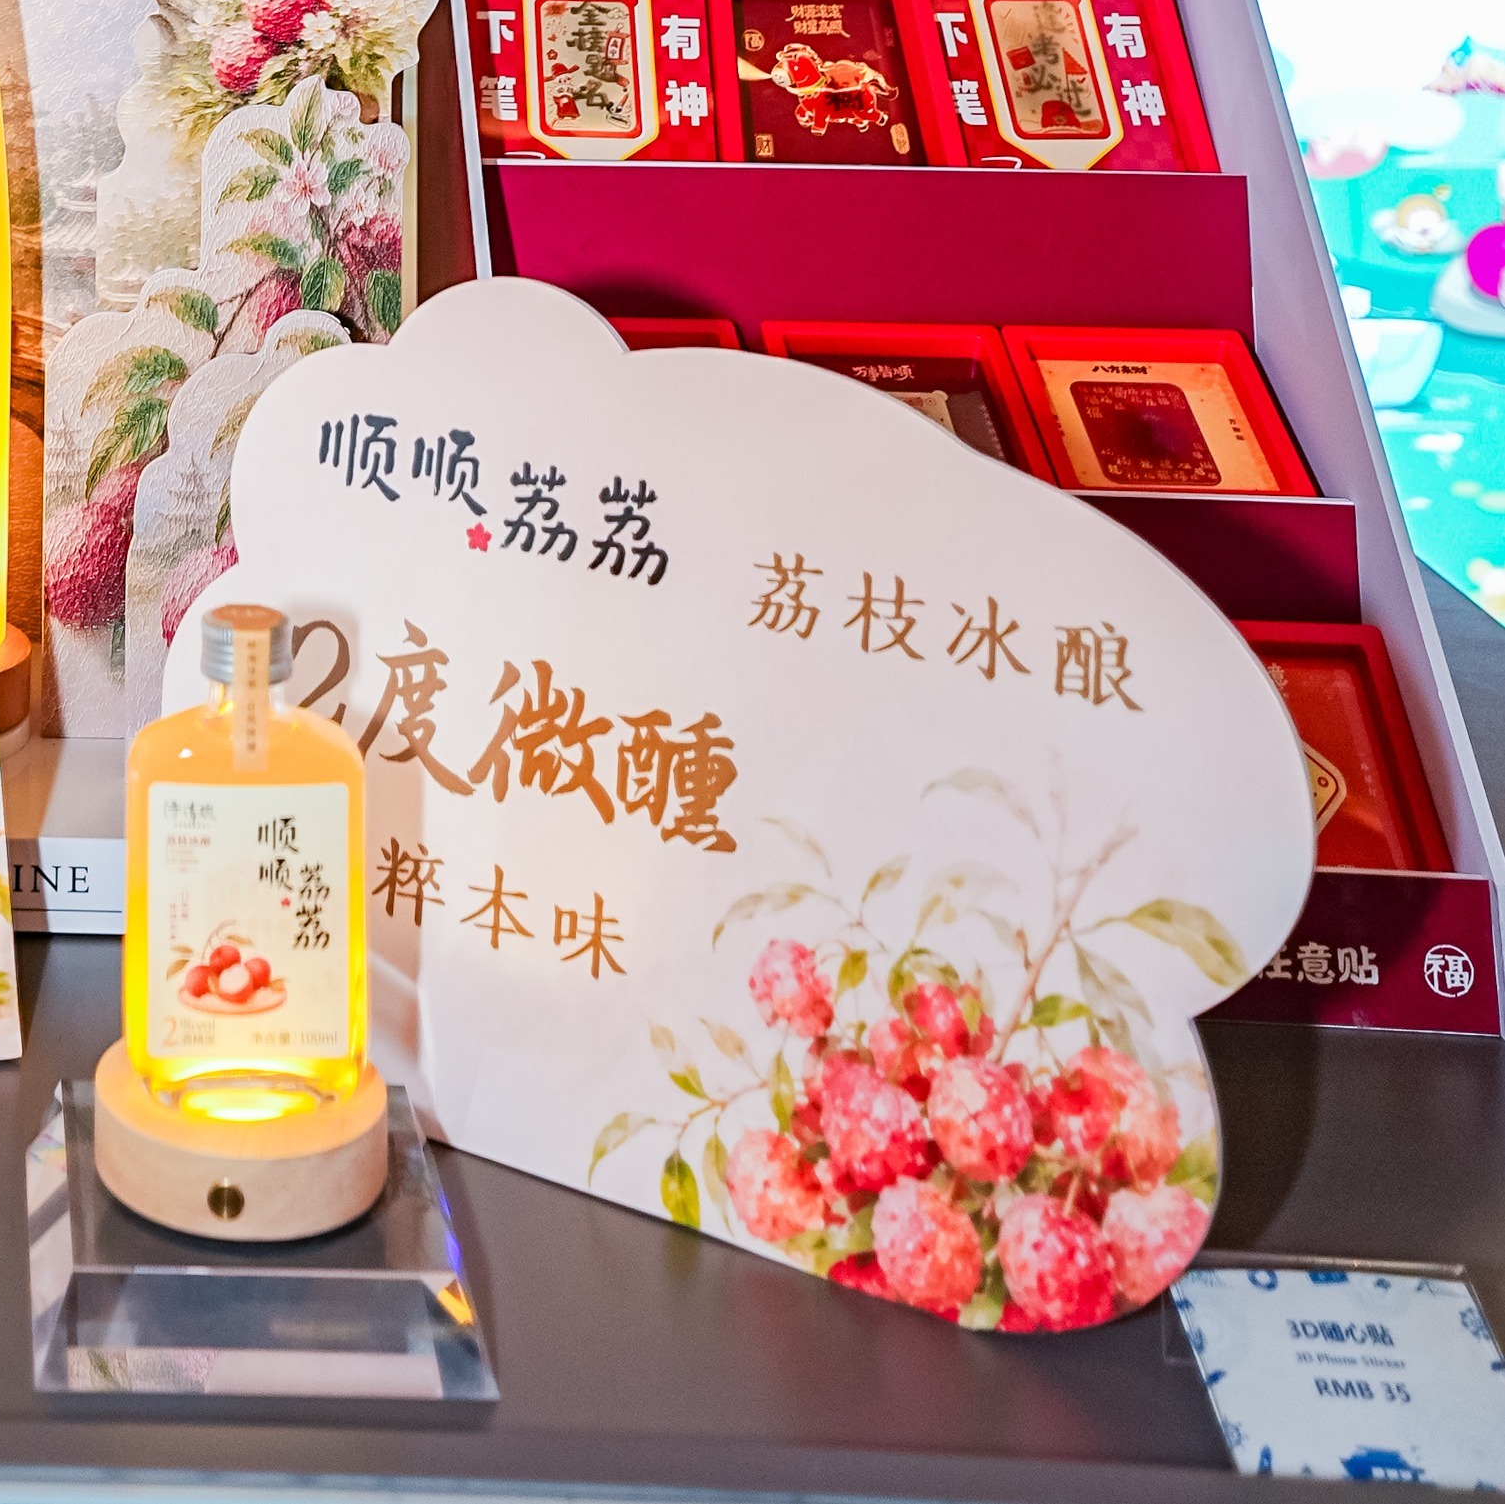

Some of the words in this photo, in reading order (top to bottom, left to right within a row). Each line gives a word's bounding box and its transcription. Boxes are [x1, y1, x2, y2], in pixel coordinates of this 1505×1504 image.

[660, 14, 709, 127] 有神
[1103, 12, 1167, 126] 有神
[318, 413, 670, 587] 顺顺荔荔
[748, 553, 1145, 713] 荔枝冰酿
[372, 836, 627, 981] 粹本味
[1426, 948, 1472, 995] 福
[161, 1014, 178, 1047] 2
[1313, 1375, 1374, 1401] RMB
[1381, 1380, 1412, 1404] 35
[1316, 1351, 1358, 1366] Phone
